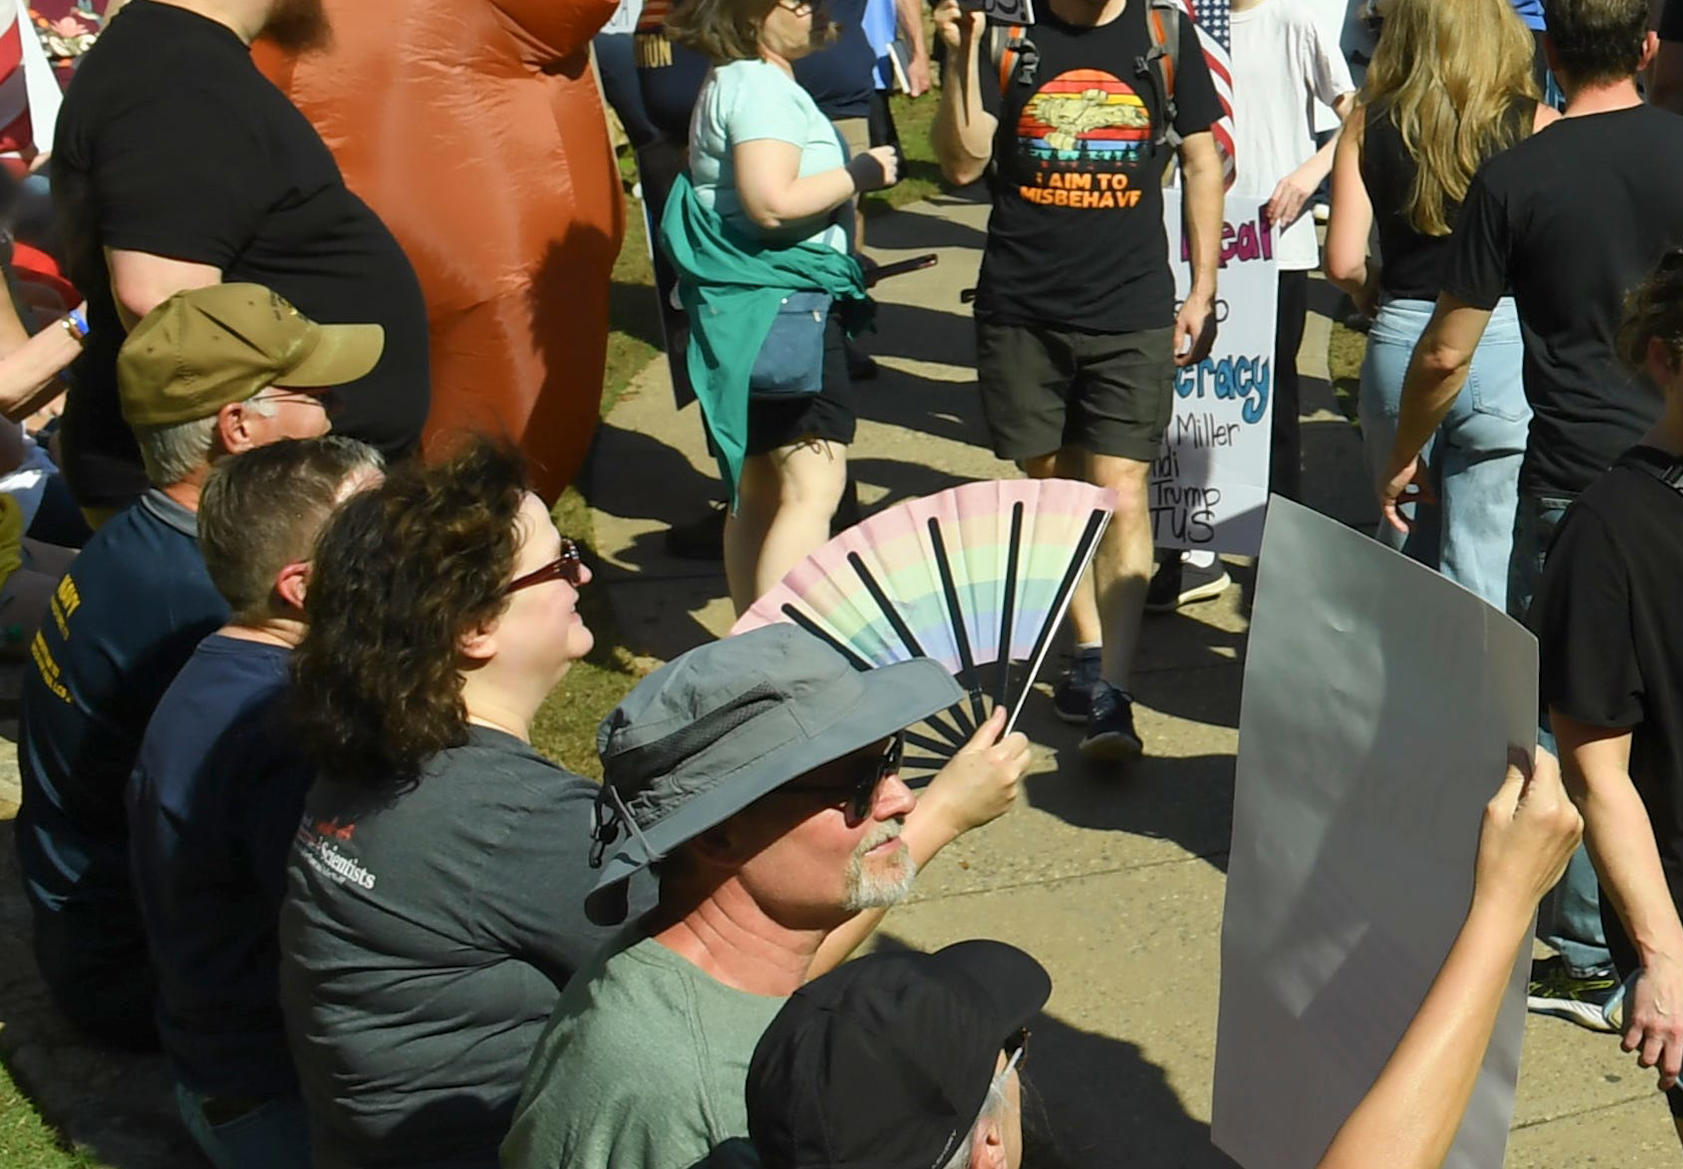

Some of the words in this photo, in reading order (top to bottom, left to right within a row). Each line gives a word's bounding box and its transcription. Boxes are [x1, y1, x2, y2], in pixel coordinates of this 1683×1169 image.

[1049, 172, 1092, 190] AIM
[1097, 172, 1128, 190] TO
[1181, 204, 1275, 269] eal
[1175, 412, 1240, 451] Miller
[1152, 479, 1221, 510] Trump
[320, 837, 377, 890] Scientists
